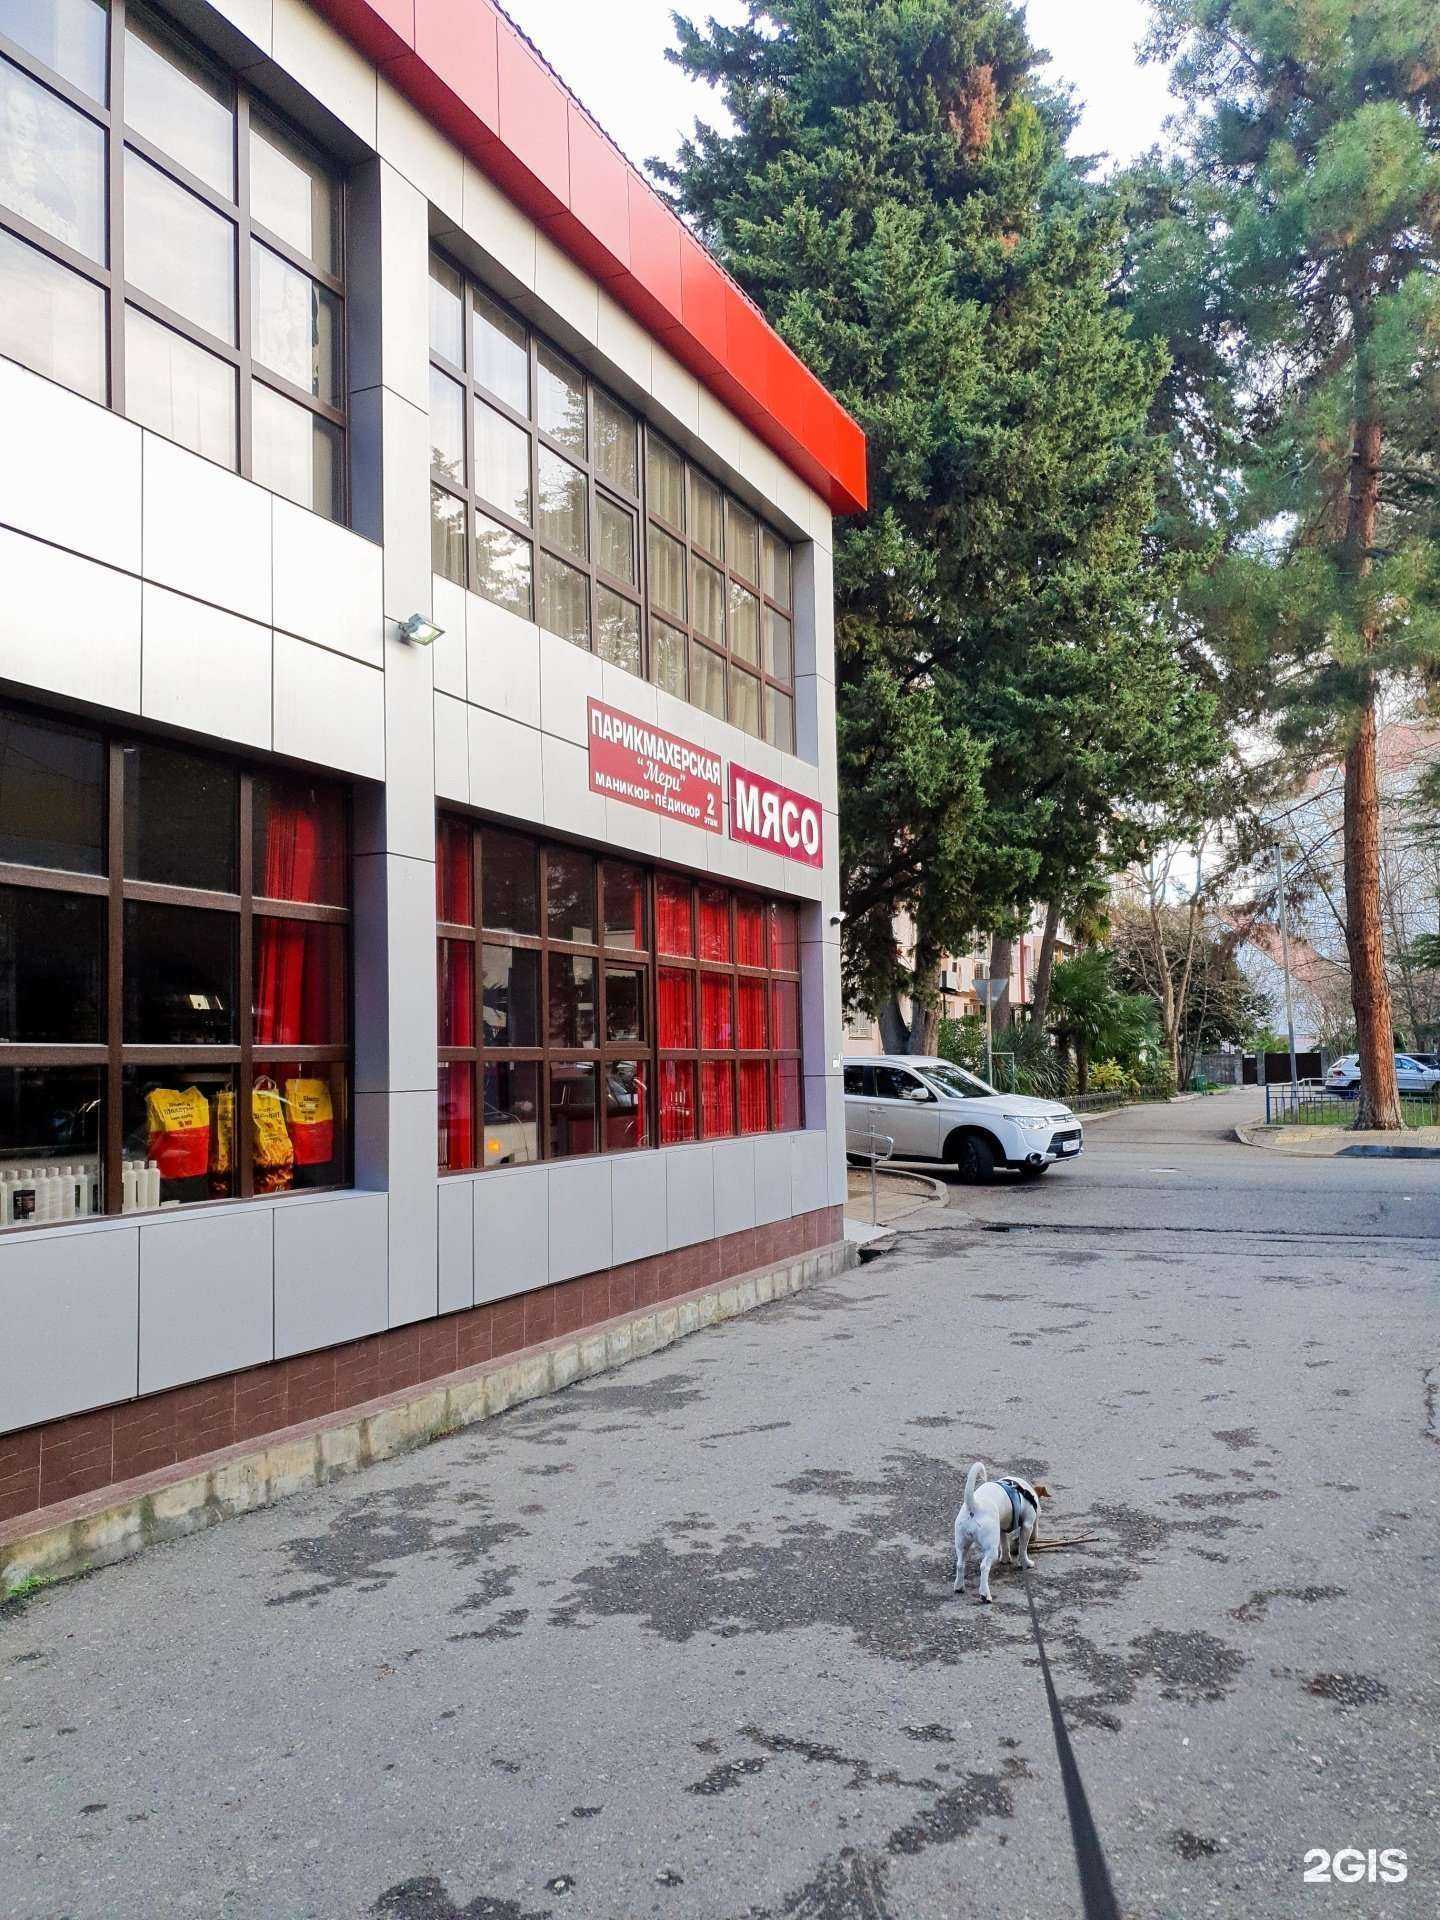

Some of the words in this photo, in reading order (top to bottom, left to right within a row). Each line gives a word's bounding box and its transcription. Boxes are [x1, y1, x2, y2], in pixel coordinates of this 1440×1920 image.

[591, 708, 721, 786] ПАРИКМАХЕРСКАЯ
[706, 792, 716, 816] 2
[735, 777, 819, 856] МЯСО
